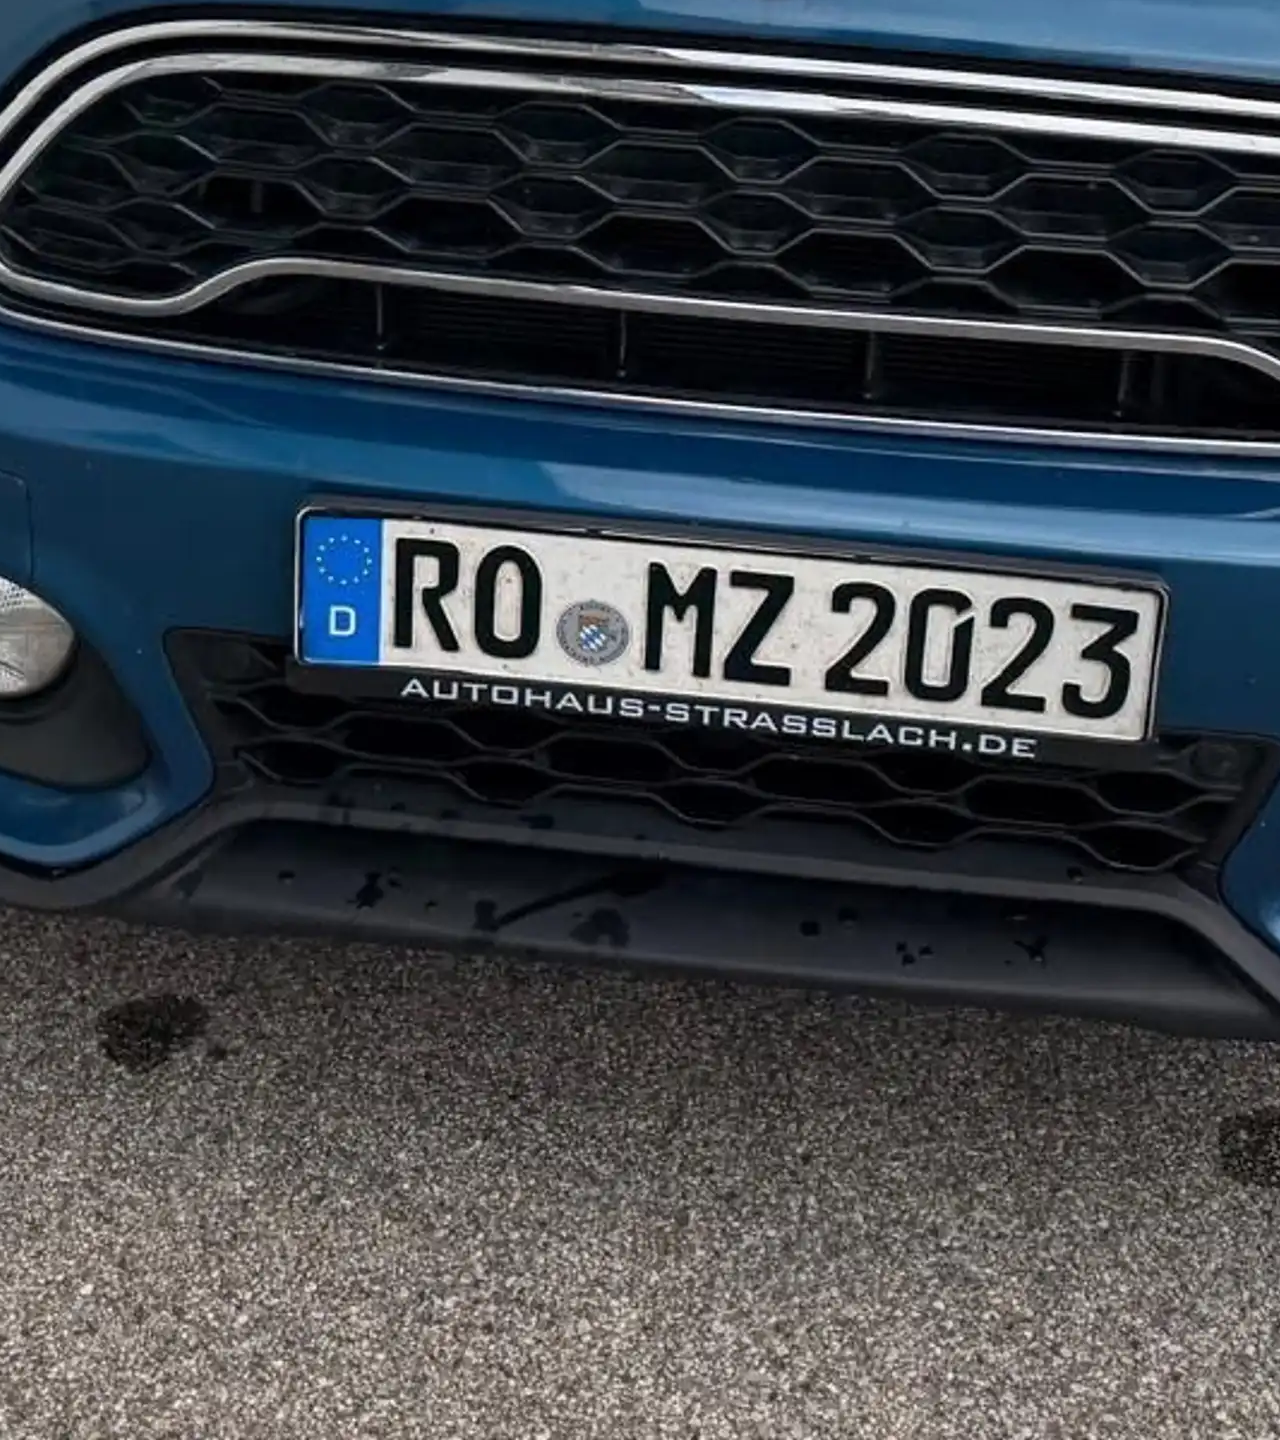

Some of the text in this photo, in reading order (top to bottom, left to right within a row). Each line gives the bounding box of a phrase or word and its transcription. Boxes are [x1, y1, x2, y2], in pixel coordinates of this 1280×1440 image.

[328, 605, 357, 636] D
[393, 536, 543, 659] RO
[643, 561, 795, 687] MZ
[824, 580, 1141, 719] 2023
[400, 678, 1038, 759] AUTOHAUS-STRASSLACH.DE
